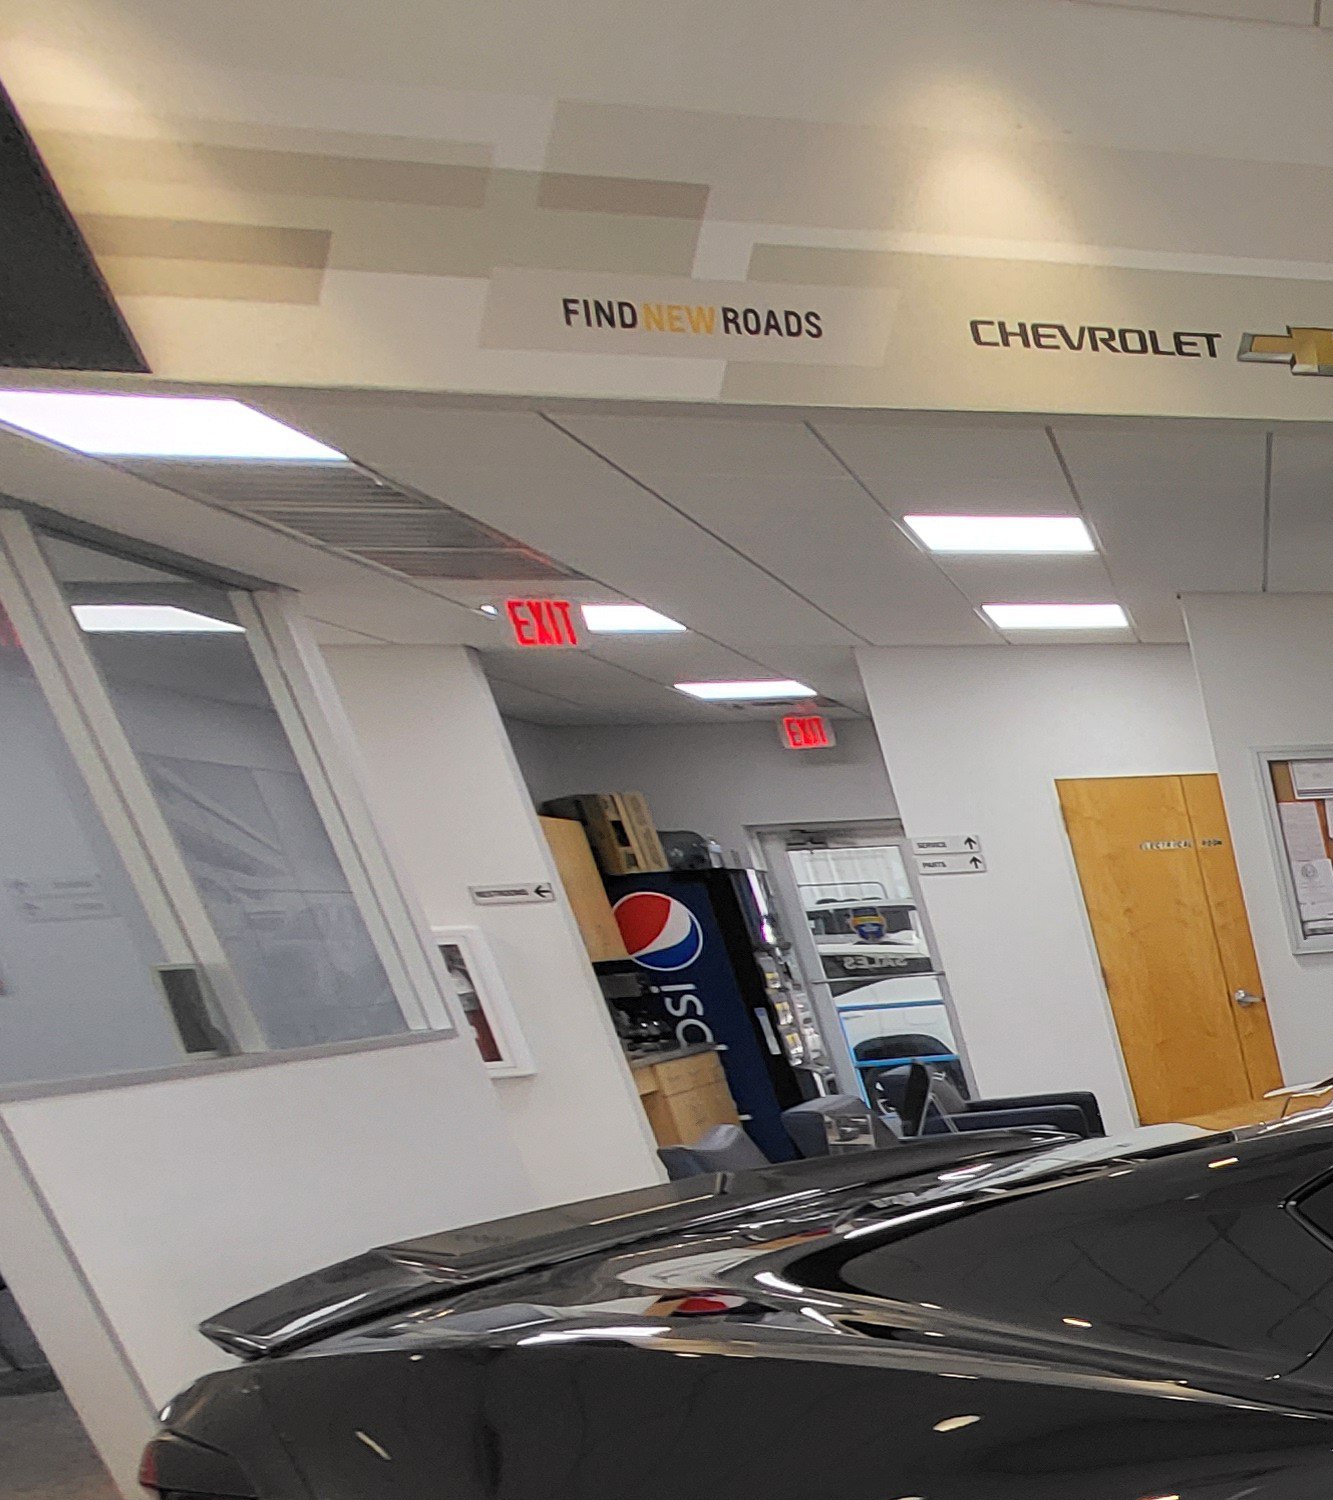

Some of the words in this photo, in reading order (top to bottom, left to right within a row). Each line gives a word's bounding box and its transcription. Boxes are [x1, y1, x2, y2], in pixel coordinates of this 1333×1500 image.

[562, 298, 638, 329] FIND
[642, 303, 716, 335] NEW
[721, 307, 823, 339] ROADS
[969, 320, 1222, 358] CHEVROLET
[506, 600, 578, 646] EXIT
[783, 716, 829, 748] EXIT
